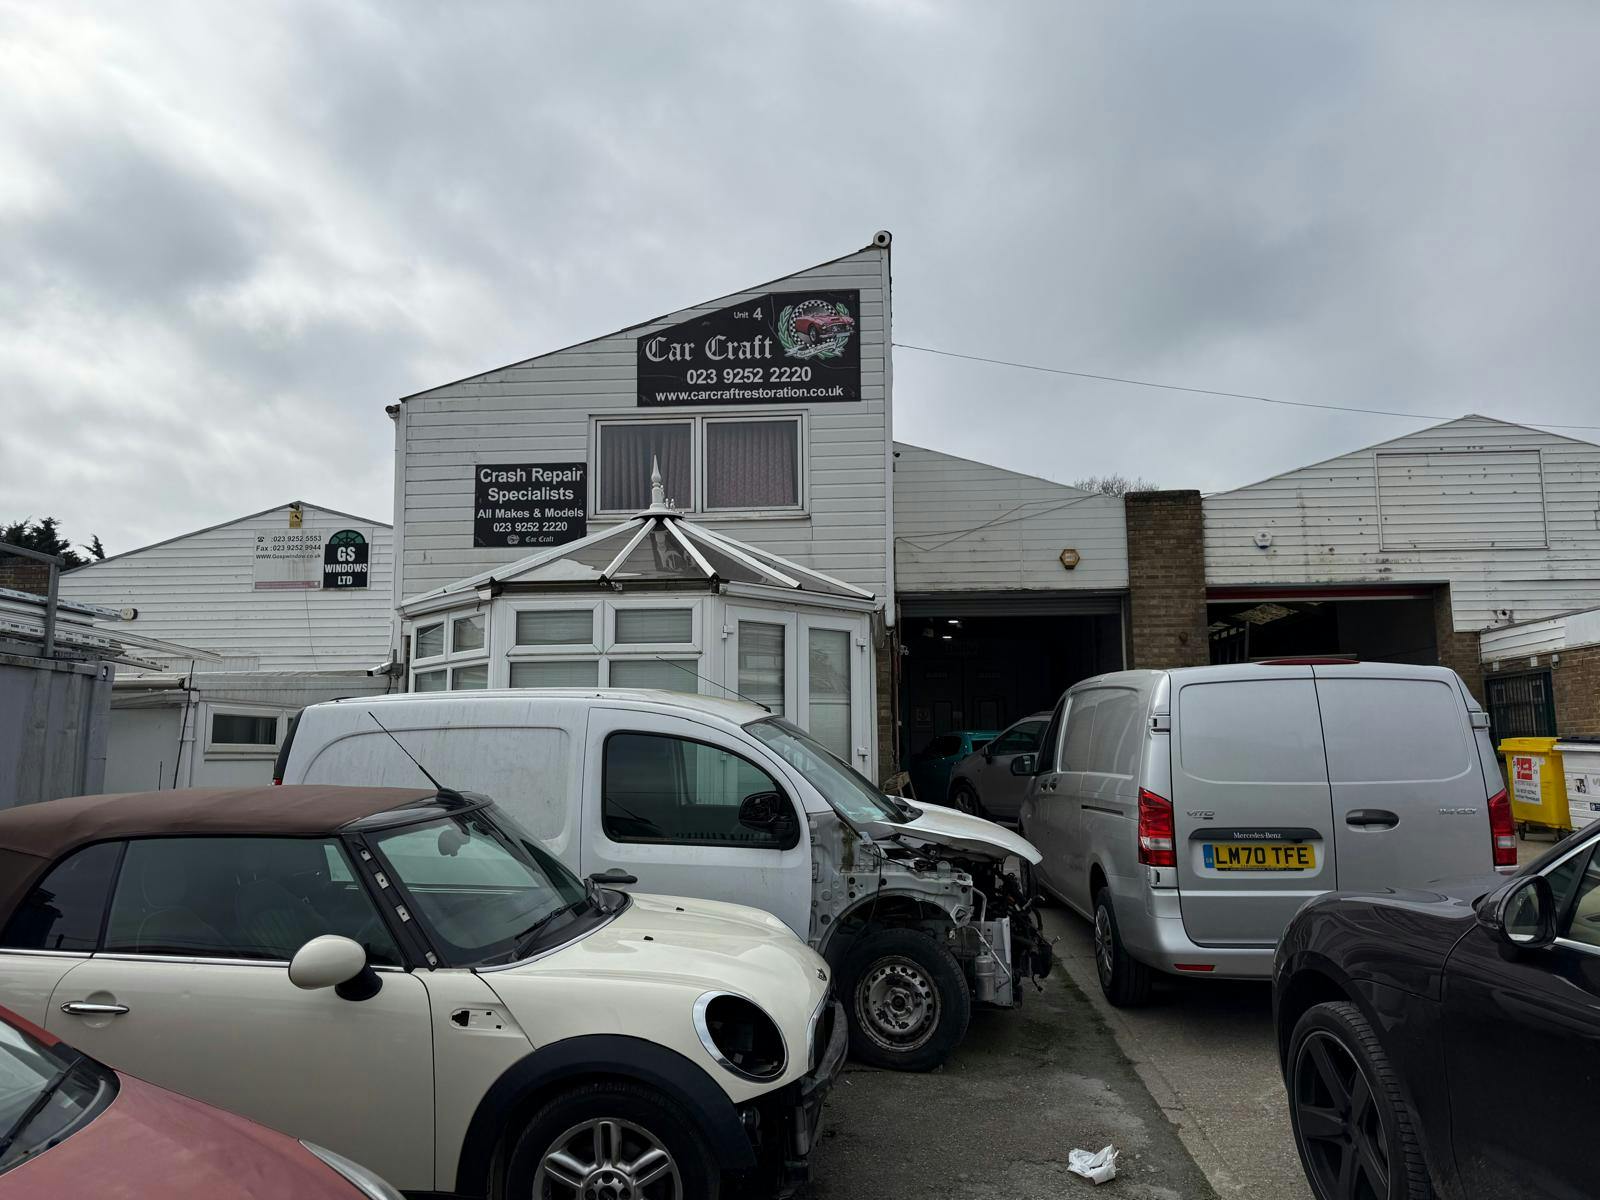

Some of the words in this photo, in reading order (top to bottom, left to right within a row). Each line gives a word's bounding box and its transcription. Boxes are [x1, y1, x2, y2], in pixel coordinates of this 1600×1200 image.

[733, 311, 749, 319] Unit
[753, 307, 763, 321] 4
[645, 336, 696, 362] Car
[704, 335, 773, 360] Craft
[686, 368, 717, 384] 023
[723, 367, 764, 383] 9252
[769, 366, 812, 382] 2220
[655, 385, 844, 401] www.carcraftrestoration.co.uk
[480, 468, 526, 482] Crash
[531, 467, 583, 485] Repair
[488, 486, 574, 504] Specialists
[477, 509, 492, 519] All
[495, 508, 530, 518] Makes
[533, 508, 541, 518] &
[544, 508, 584, 518] Models
[493, 522, 512, 532] 023
[515, 522, 539, 532] 9252
[542, 521, 568, 531] 2220
[337, 546, 356, 562] GS
[324, 563, 368, 573] WINDOWS
[337, 575, 353, 585] LTD
[1215, 847, 1266, 864] LM70
[1271, 847, 1310, 864] TFE
